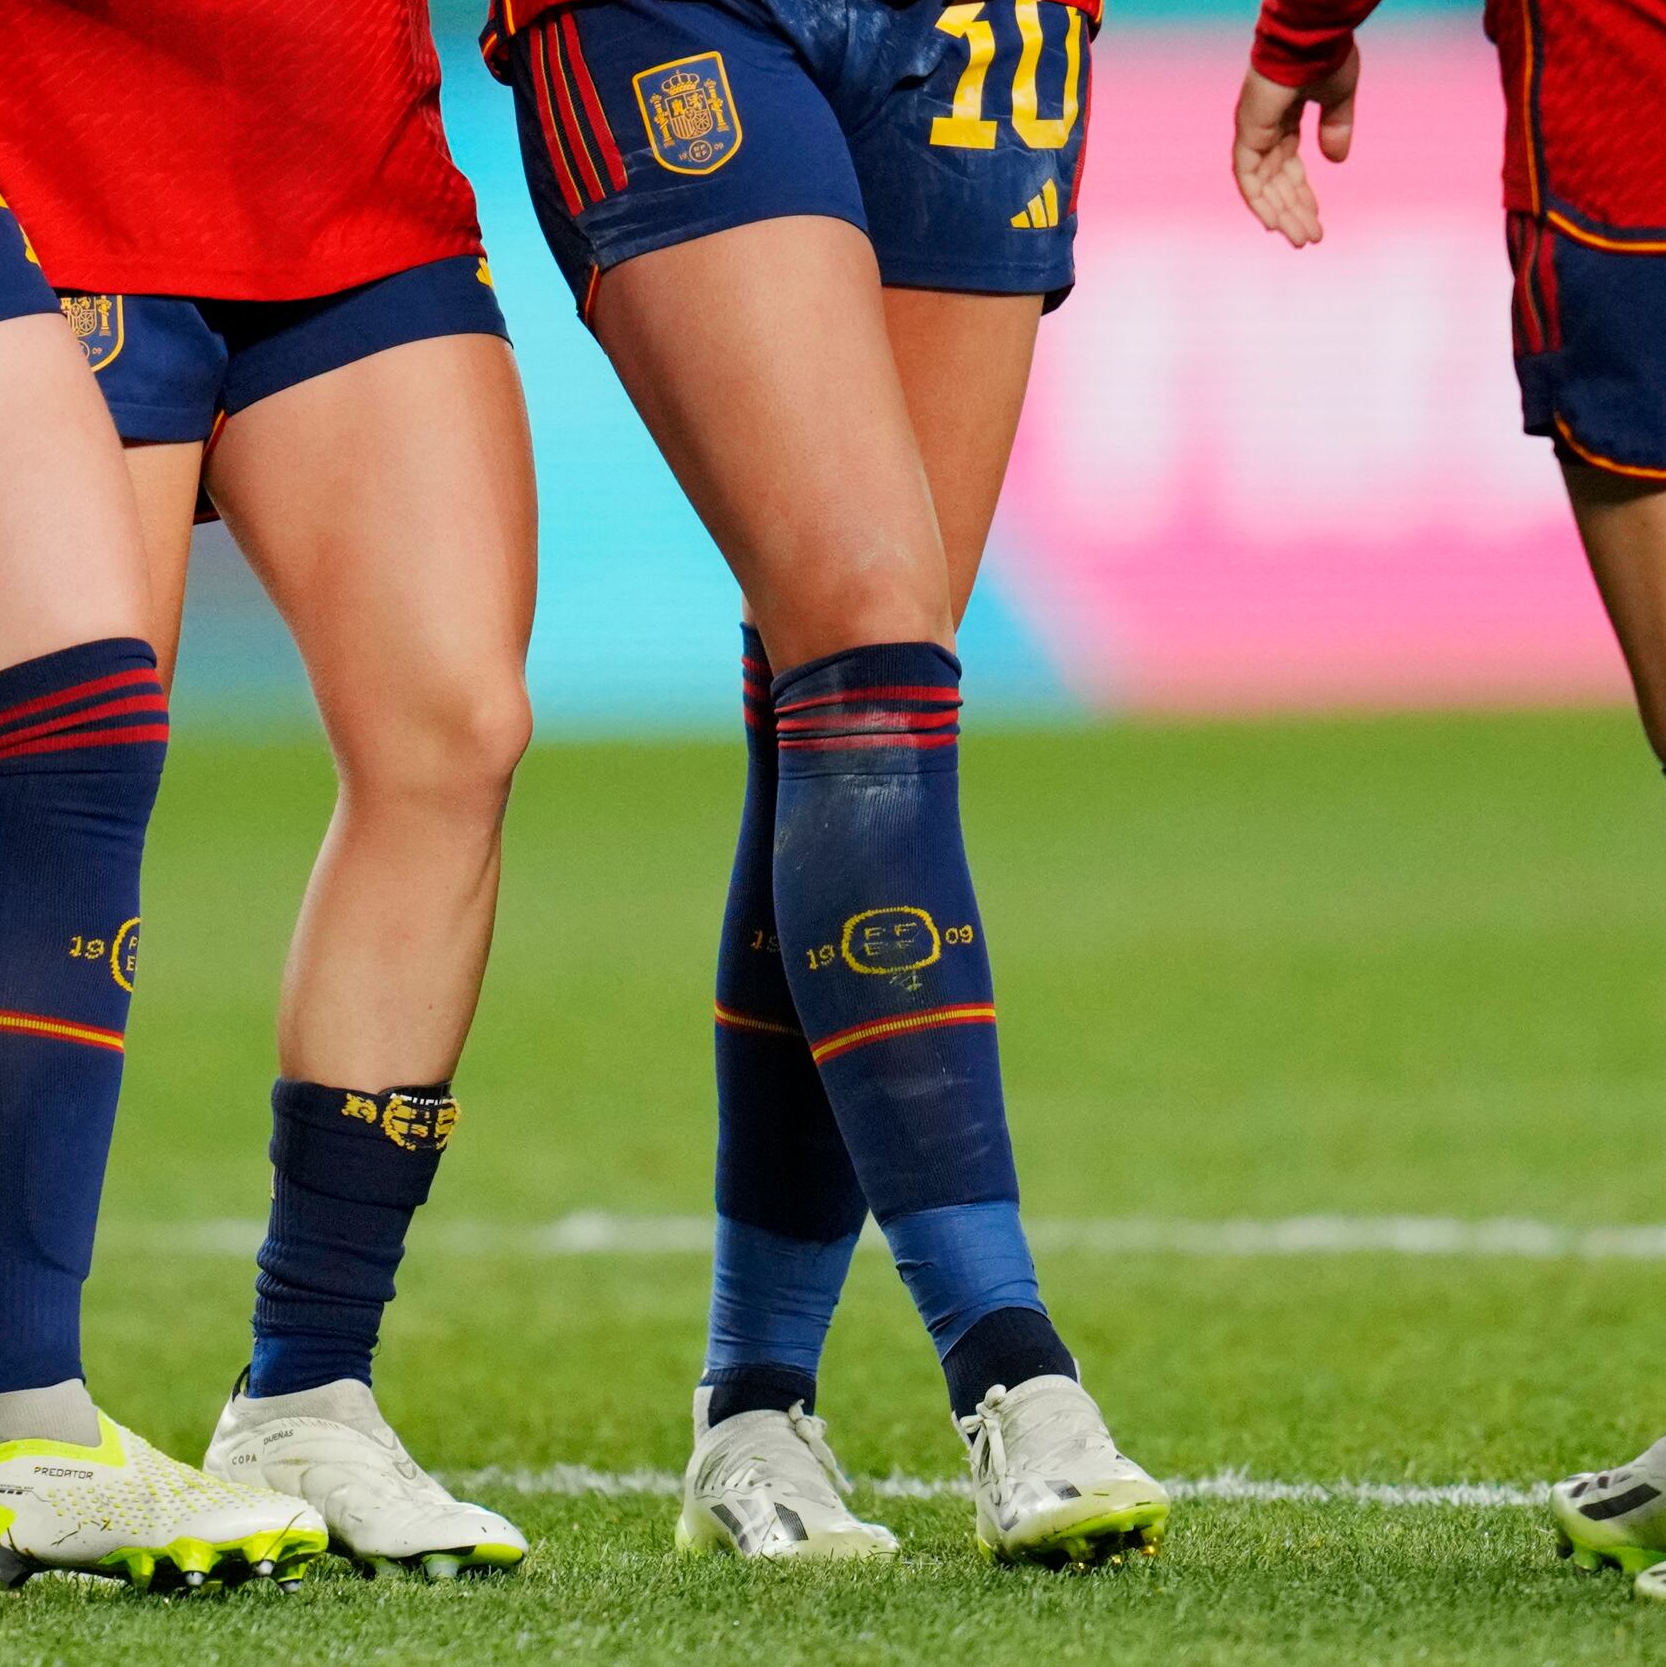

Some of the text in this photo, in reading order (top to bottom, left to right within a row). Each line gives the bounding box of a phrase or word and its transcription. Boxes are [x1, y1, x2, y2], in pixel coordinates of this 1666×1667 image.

[944, 924, 974, 944] 09
[68, 934, 106, 960] 19
[805, 943, 835, 972] 19
[231, 1452, 258, 1466] COPA
[34, 1466, 94, 1480] PREDATOR
